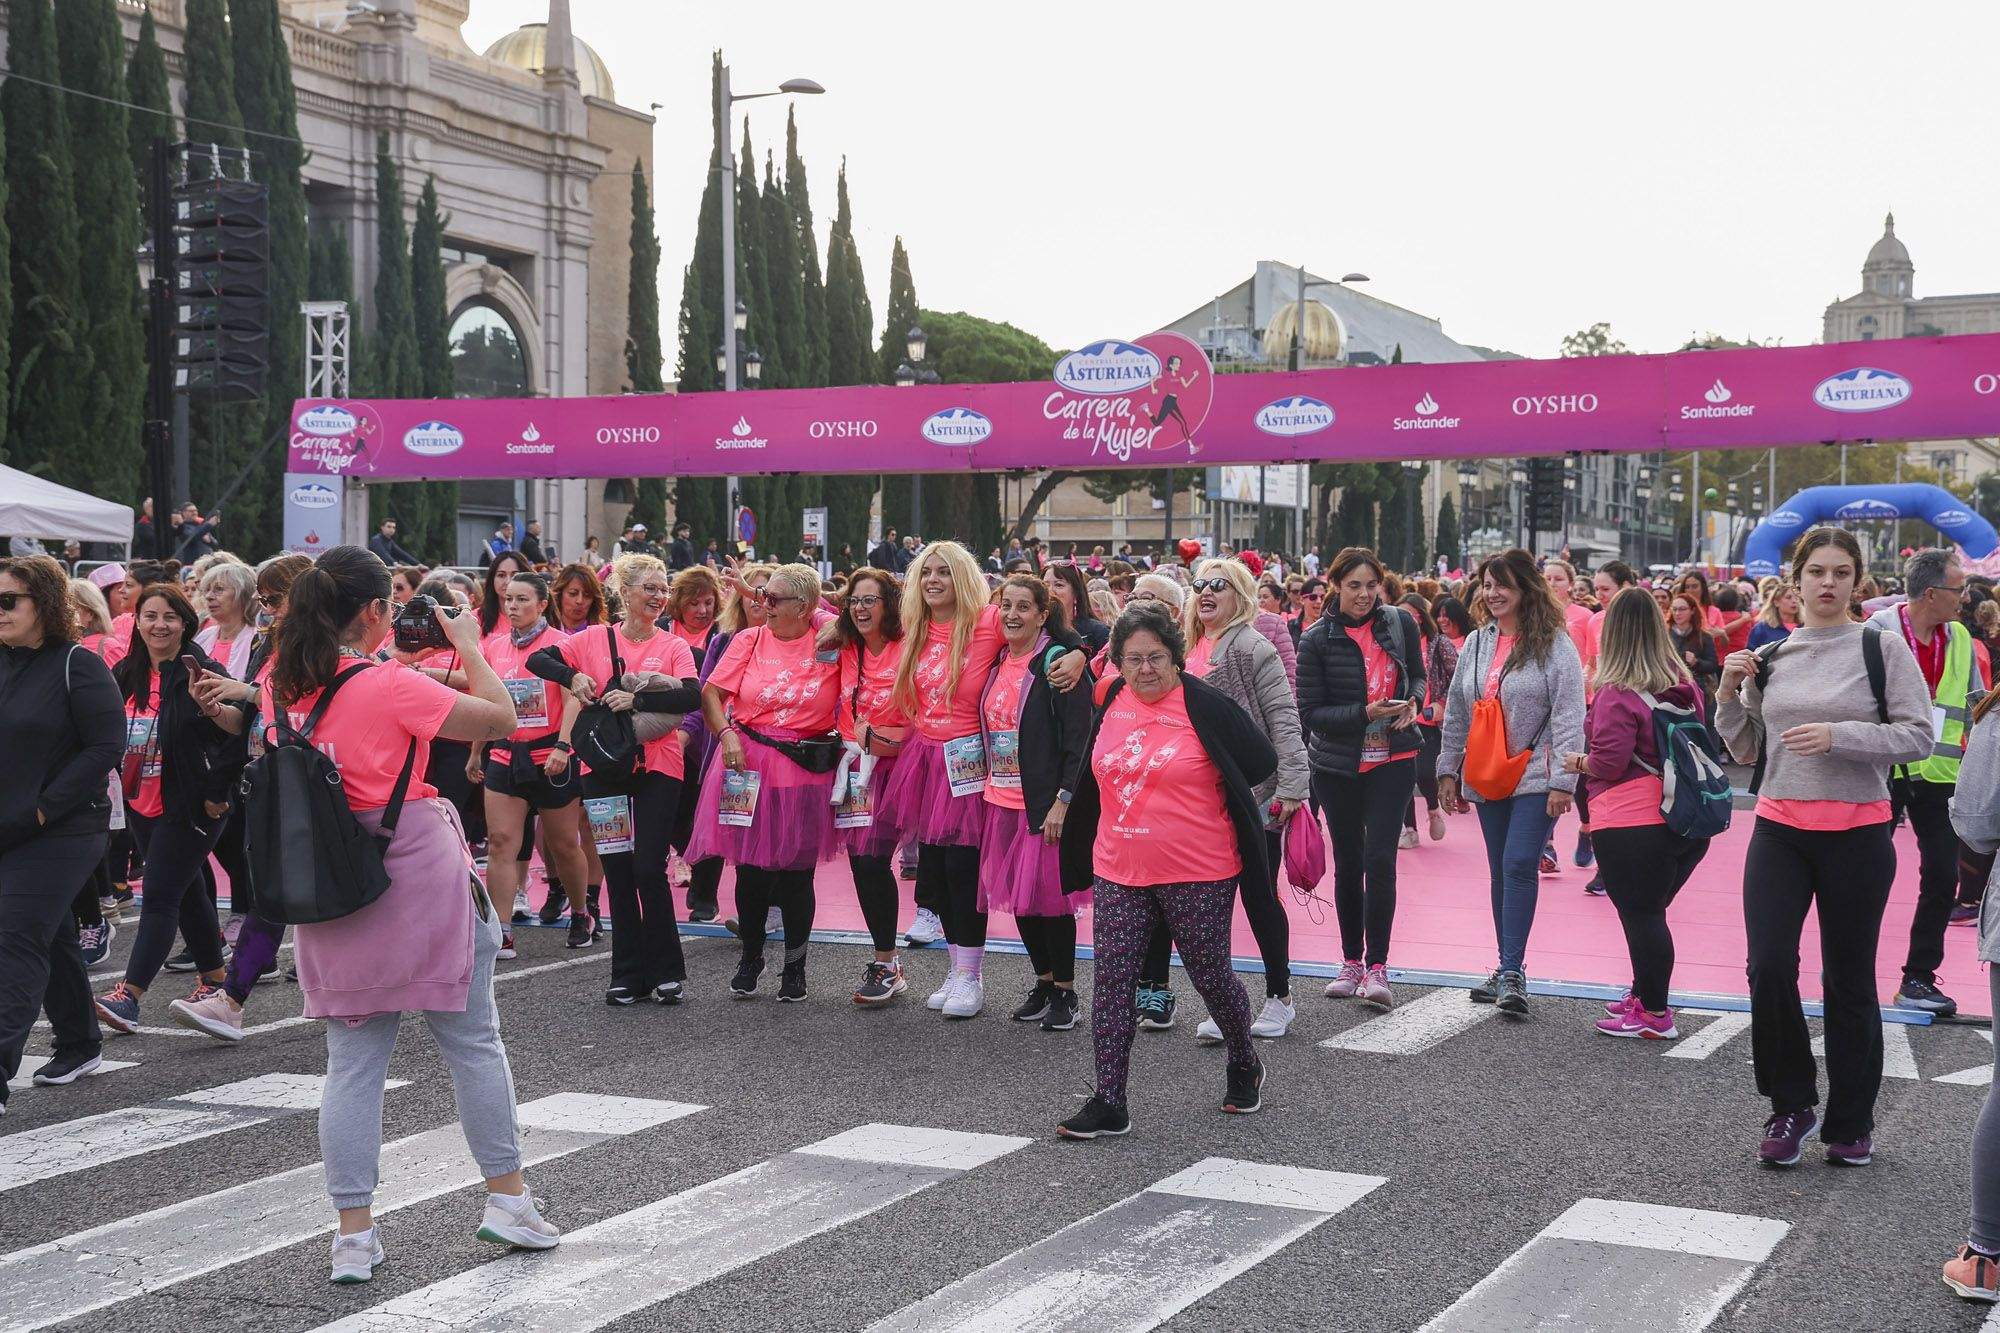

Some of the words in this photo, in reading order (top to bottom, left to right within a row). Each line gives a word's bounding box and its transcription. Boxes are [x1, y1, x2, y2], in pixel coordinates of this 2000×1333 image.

[1063, 361, 1151, 381] ASTURIANA
[1974, 374, 2000, 394] O
[1822, 385, 1903, 401] ASTURIANA
[1043, 391, 1132, 419] Carrera
[1512, 393, 1598, 415] OYSHO
[1681, 403, 1755, 419] Santander
[302, 417, 352, 428] ASTURIANA
[1261, 412, 1328, 427] ASTURIANA
[1393, 416, 1460, 430] Santander
[596, 426, 660, 444] OYSHO
[809, 420, 877, 438] OYSHO
[927, 422, 987, 436] ASTURIANA
[290, 432, 341, 448] Carrera
[408, 435, 459, 447] ASTURIANA
[715, 437, 768, 450] Santander
[1063, 420, 1079, 440] de
[1083, 420, 1095, 439] la
[1091, 415, 1162, 461] Mujer
[506, 443, 555, 454] Santander
[317, 448, 357, 473] Mujer
